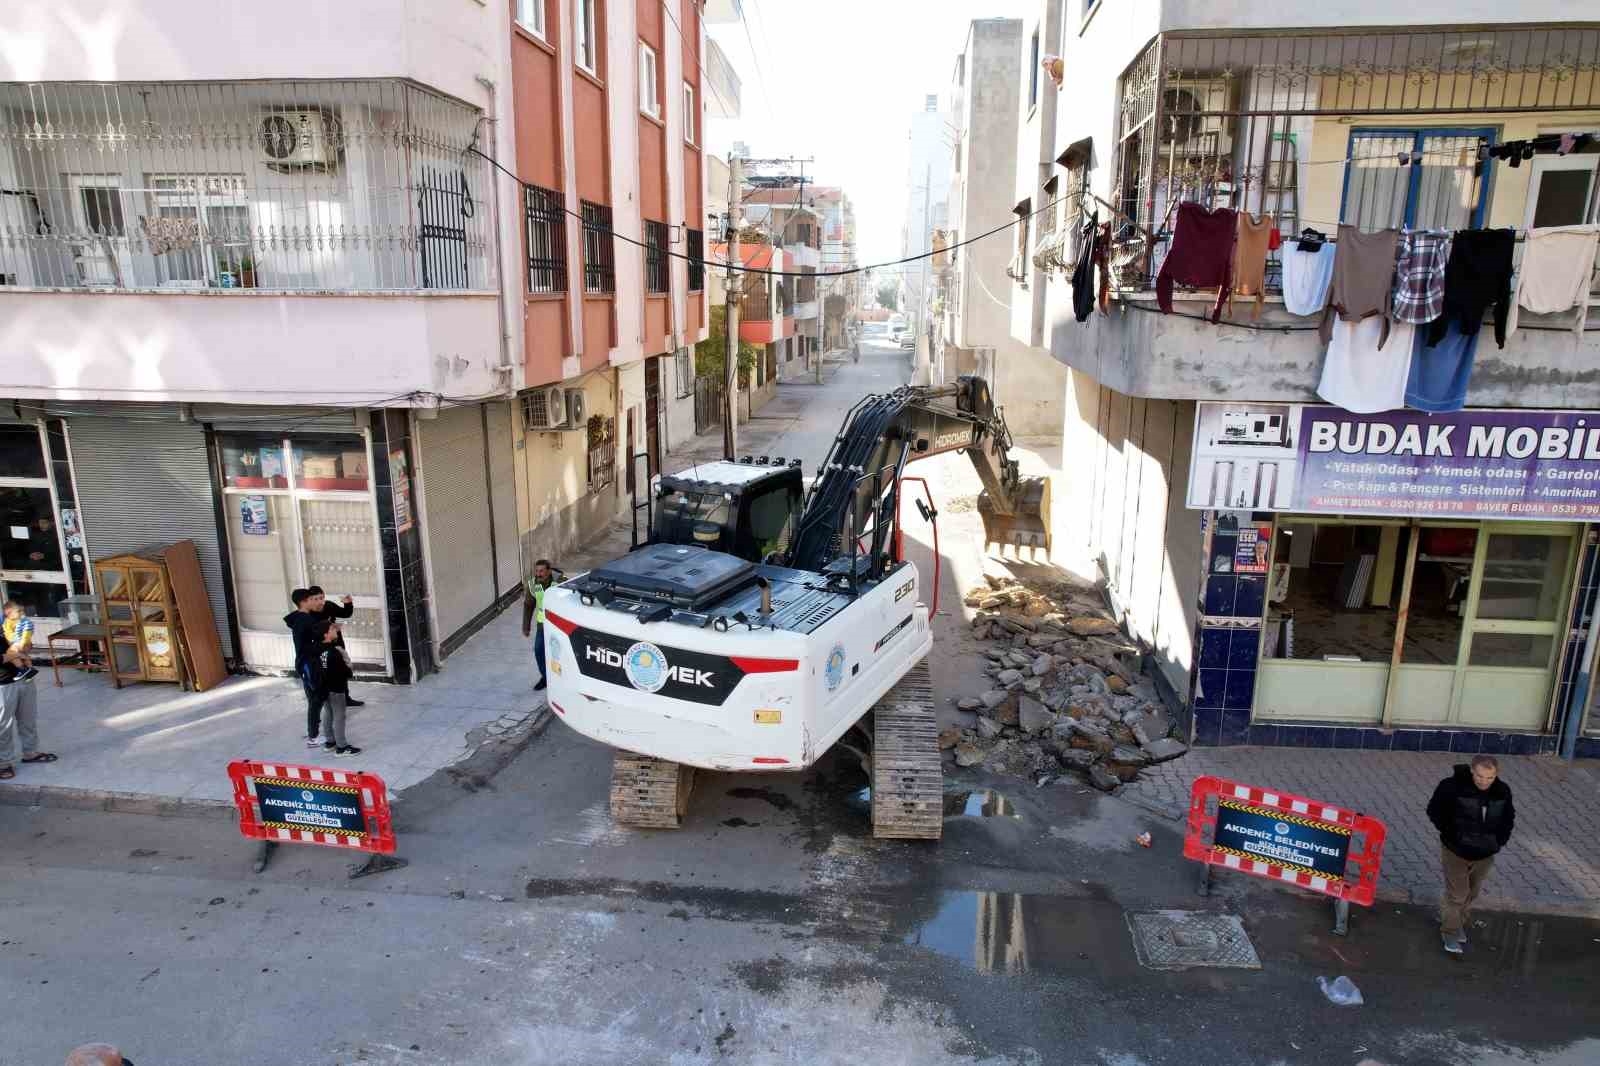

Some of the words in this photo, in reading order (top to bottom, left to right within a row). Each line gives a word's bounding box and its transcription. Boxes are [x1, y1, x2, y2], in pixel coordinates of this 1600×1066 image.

[1310, 420, 1456, 457] BUDAK
[1466, 419, 1600, 460] MOBİL
[1378, 463, 1418, 476] Odası
[1434, 465, 1481, 478] Yemek
[1486, 467, 1527, 479] odası
[1546, 468, 1600, 481] Gardol
[1402, 482, 1453, 495] Pencere
[1459, 484, 1525, 497] Sistemleri
[1541, 486, 1597, 498] Amerikan
[1511, 502, 1545, 512] BUDAK
[895, 579, 915, 602] 230
[265, 798, 304, 809] AKDENİZ
[305, 802, 357, 815] BELEDİYESİ
[1224, 823, 1272, 840] AKDENİZ
[1274, 835, 1340, 857] BELEDİYESİ
